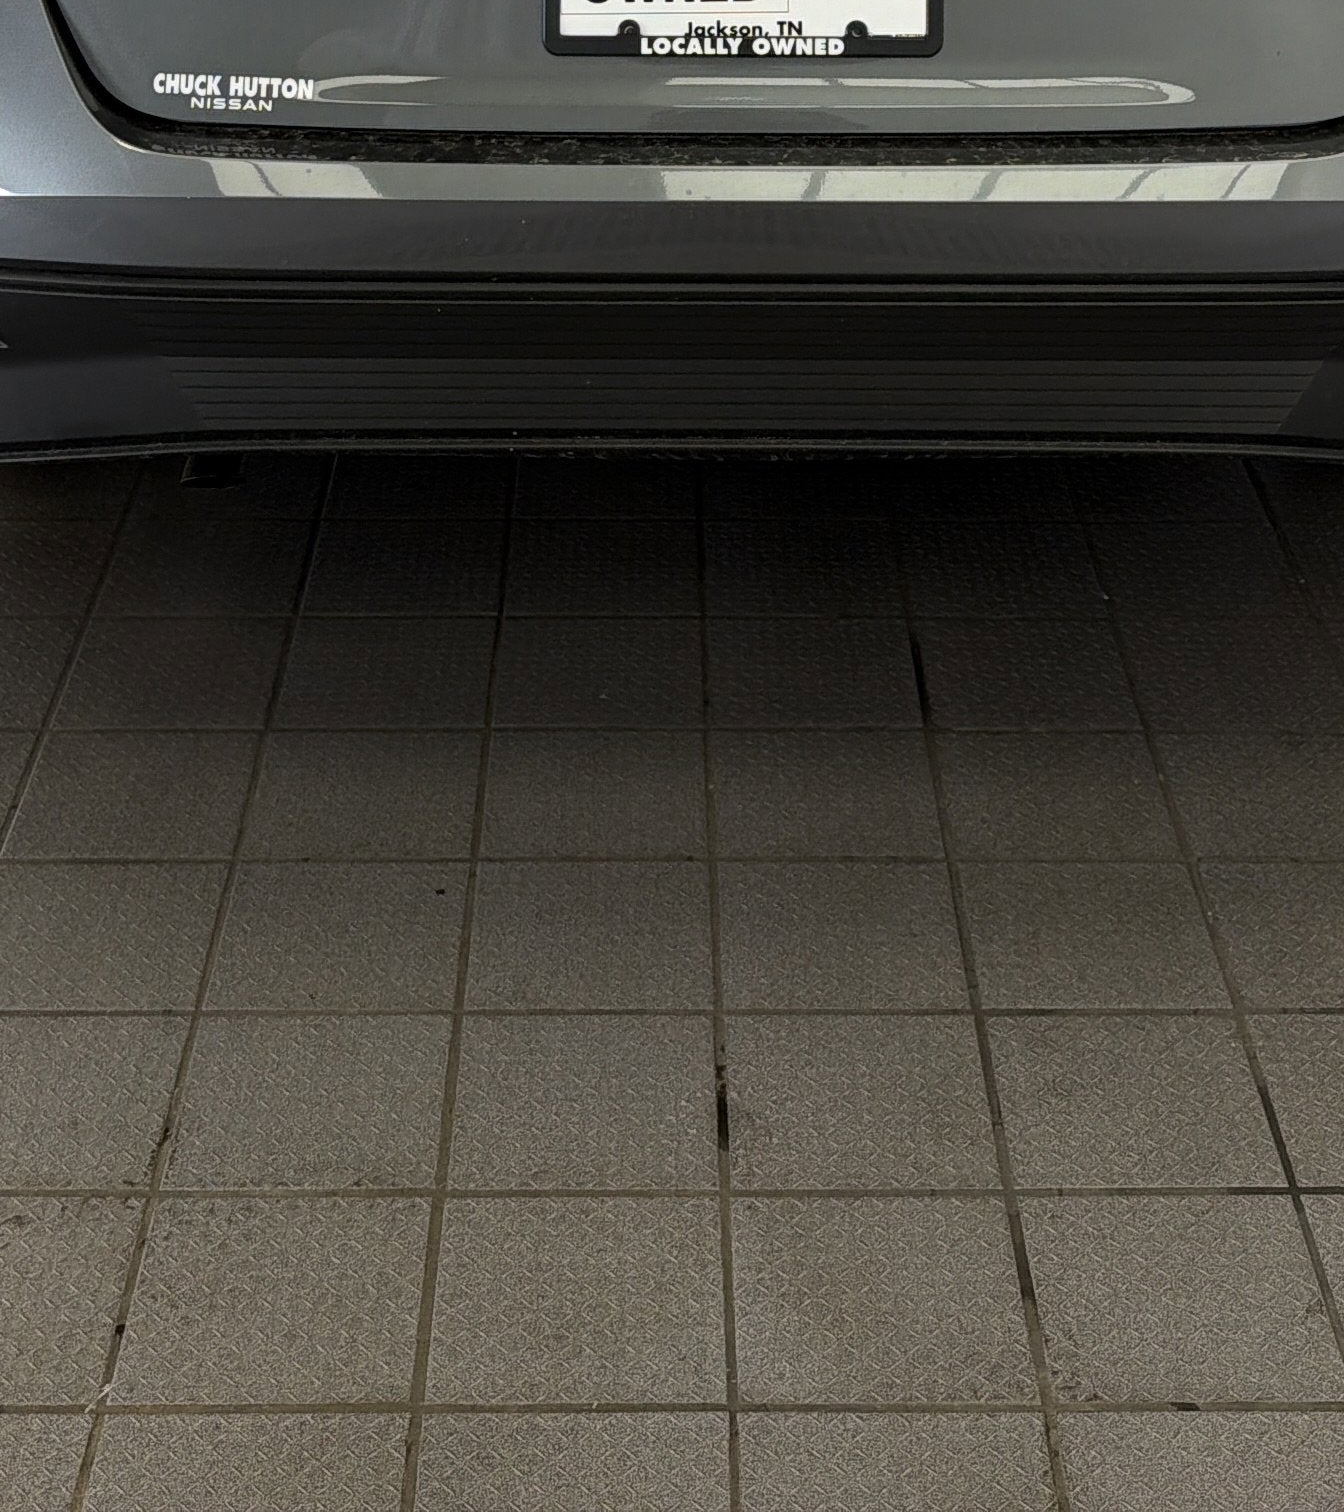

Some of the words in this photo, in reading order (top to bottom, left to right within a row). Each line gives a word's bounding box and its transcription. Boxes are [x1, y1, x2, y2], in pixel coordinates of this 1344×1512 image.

[685, 20, 770, 37] Jackson,
[777, 21, 803, 36] TN
[640, 38, 743, 55] LOCALLY
[752, 38, 845, 55] OWNED
[153, 73, 222, 96] CHUCK
[229, 76, 314, 100] HUTTON
[190, 96, 273, 112] NISSAN
